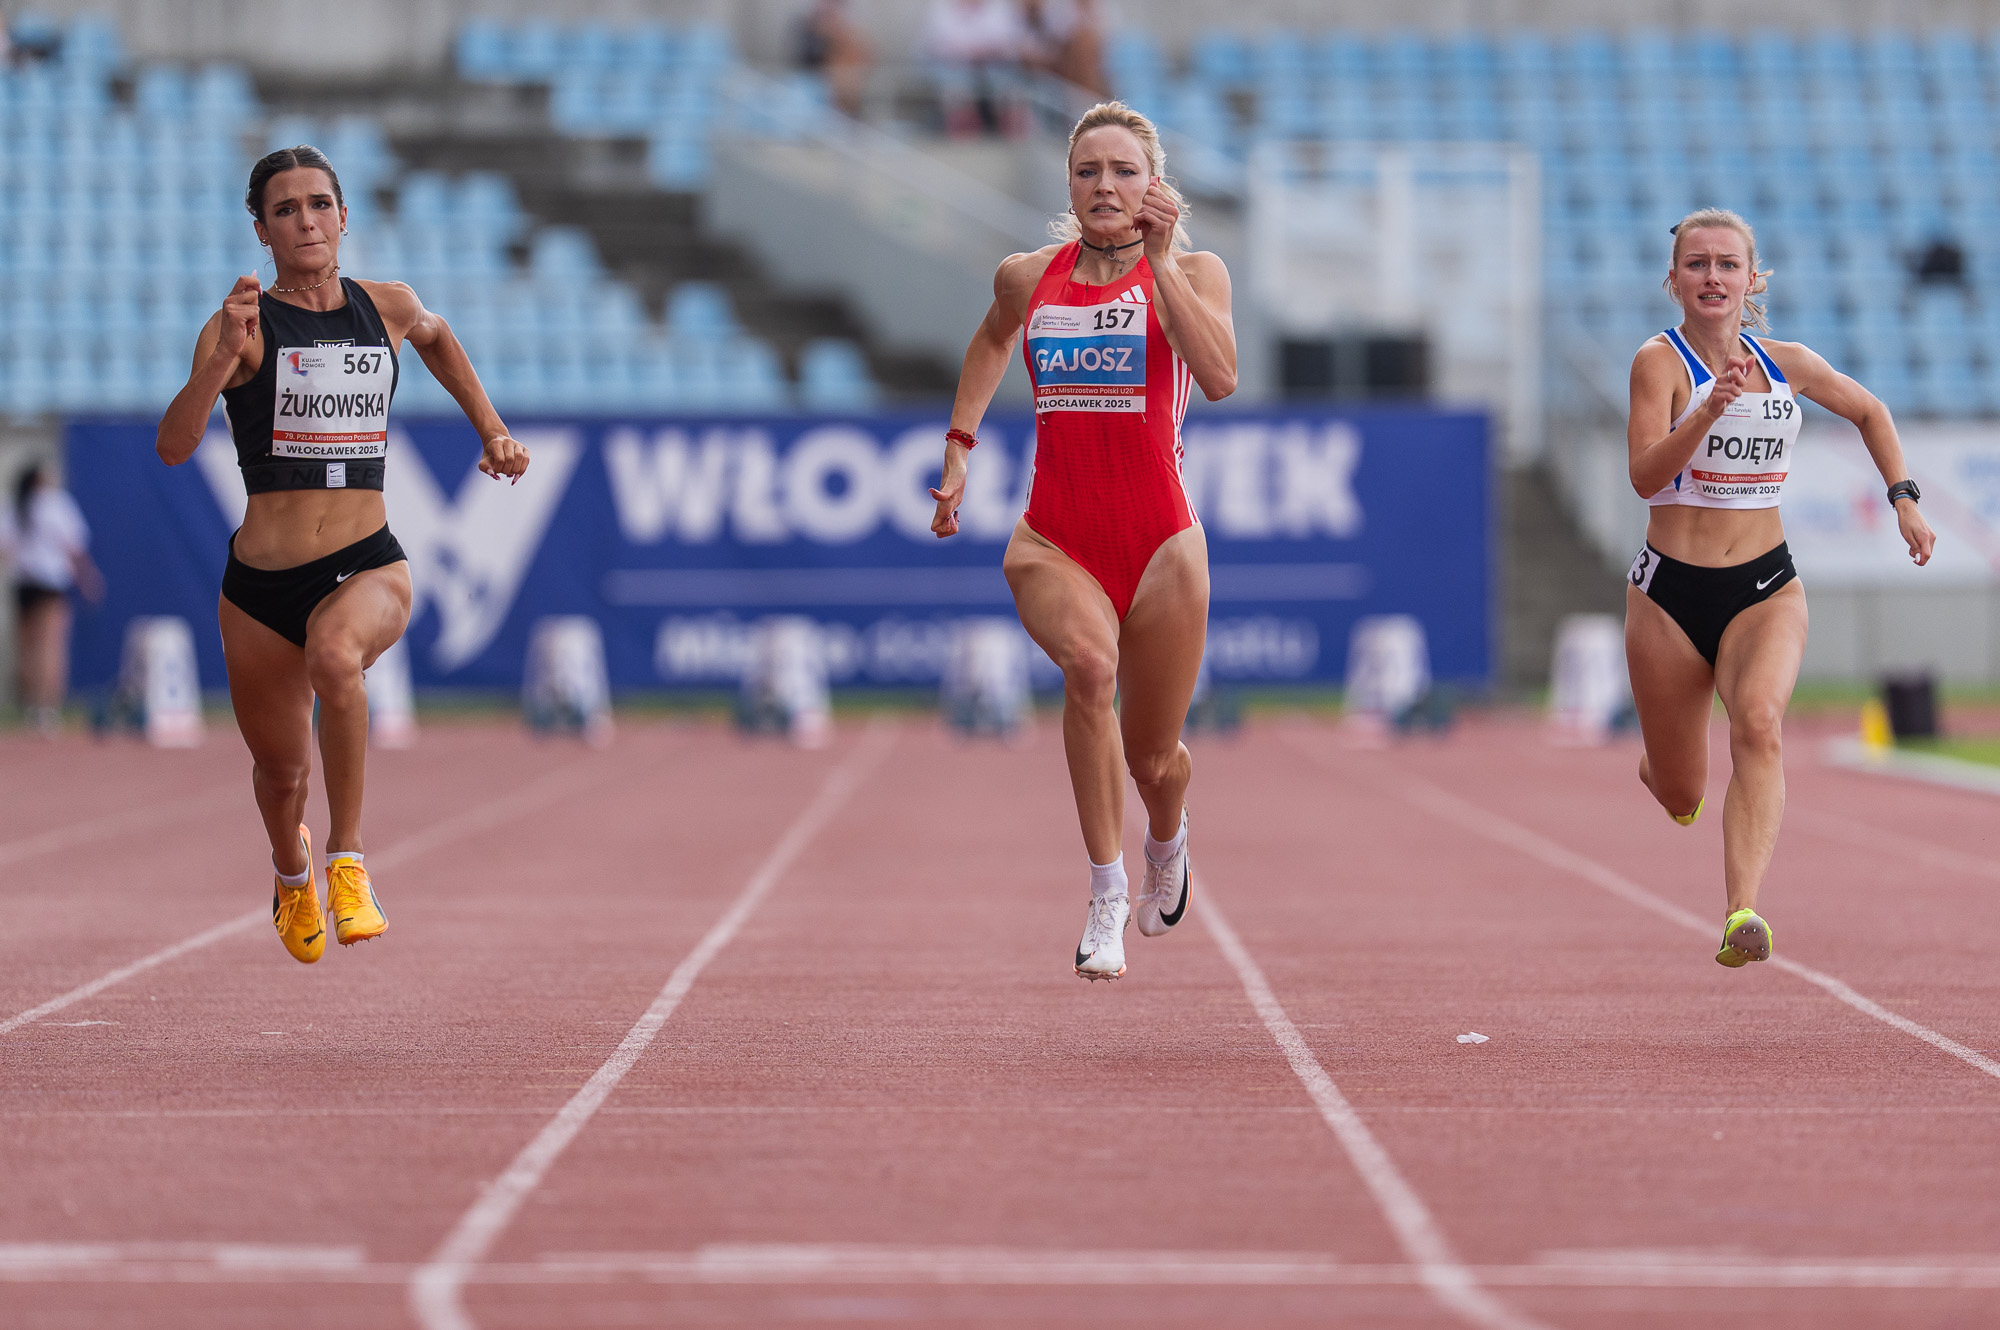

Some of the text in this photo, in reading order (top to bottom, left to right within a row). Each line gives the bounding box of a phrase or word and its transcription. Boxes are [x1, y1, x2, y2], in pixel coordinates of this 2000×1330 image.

[1093, 308, 1135, 331] 157
[343, 353, 382, 374] 567
[1035, 347, 1133, 373] GAJOSZ
[279, 387, 385, 418] ŻUKOWSKA
[1036, 399, 1131, 409] WŁOCŁAWEK 2025
[1762, 399, 1794, 420] 159
[284, 432, 295, 440] 79.
[296, 433, 313, 441] PZLA
[314, 434, 353, 442] Mistrzostwa
[286, 444, 378, 455] WŁOCŁAWEK 2025
[1706, 434, 1784, 465] POJĘTA
[602, 424, 1363, 543] WŁOCŁEK
[1701, 472, 1711, 480] 79.
[1711, 474, 1728, 482] PZLA
[1702, 484, 1758, 495] WŁOCŁAWEK
[1632, 549, 1650, 586] 3
